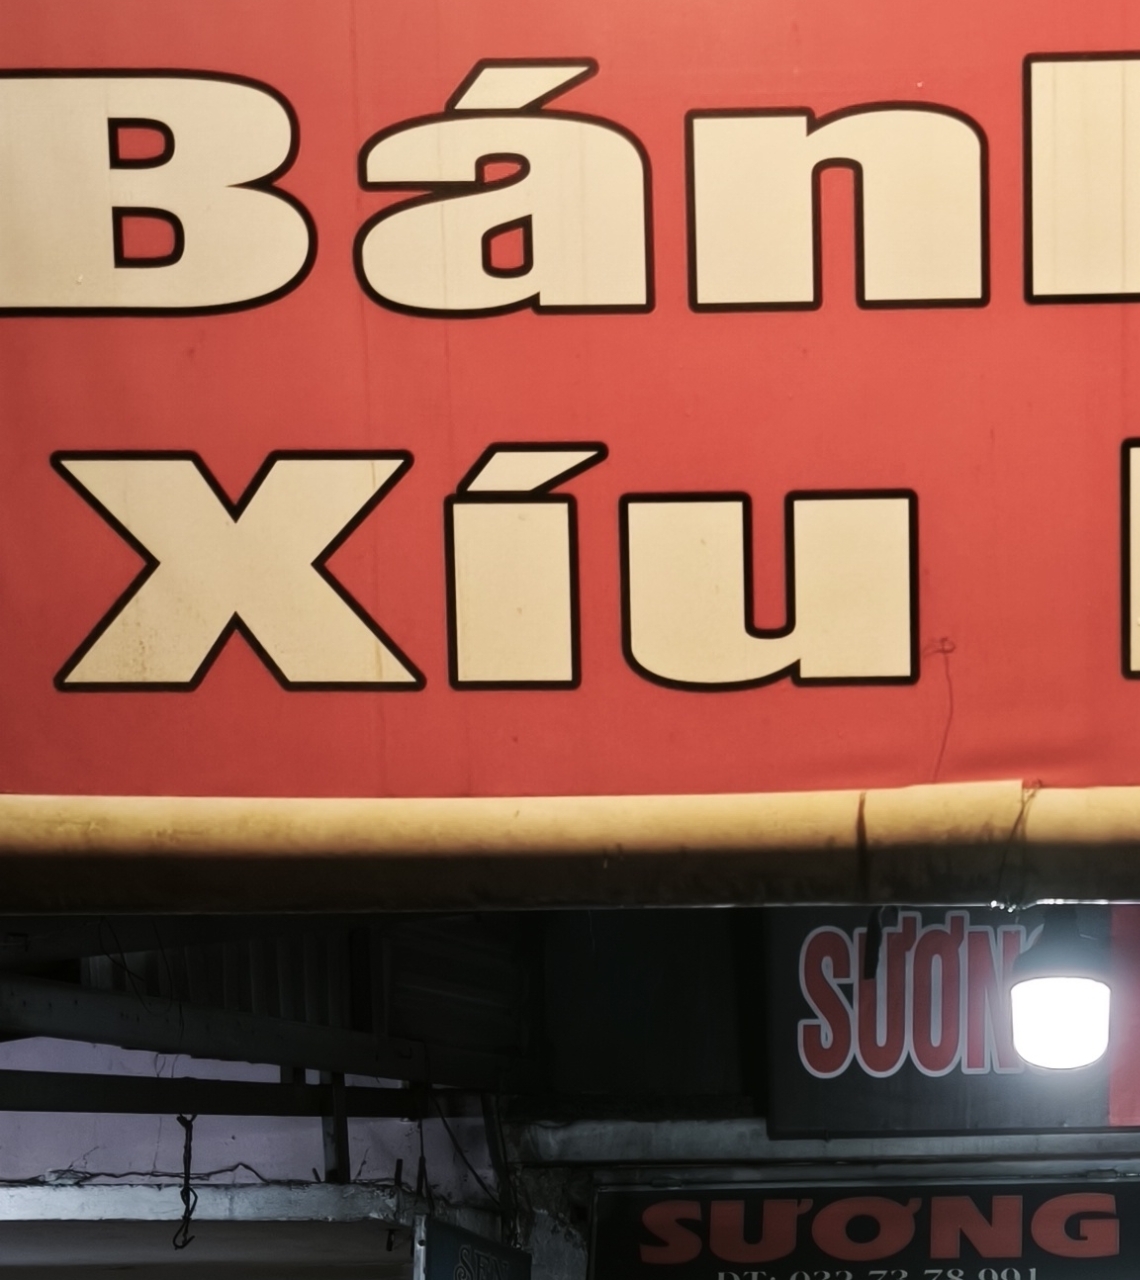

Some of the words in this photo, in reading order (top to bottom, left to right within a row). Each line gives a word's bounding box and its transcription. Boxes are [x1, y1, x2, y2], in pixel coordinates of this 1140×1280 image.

[51, 440, 921, 693] Xíu
[798, 909, 1042, 1078] SƯƠN
[639, 1190, 1120, 1265] SƯƠNG
